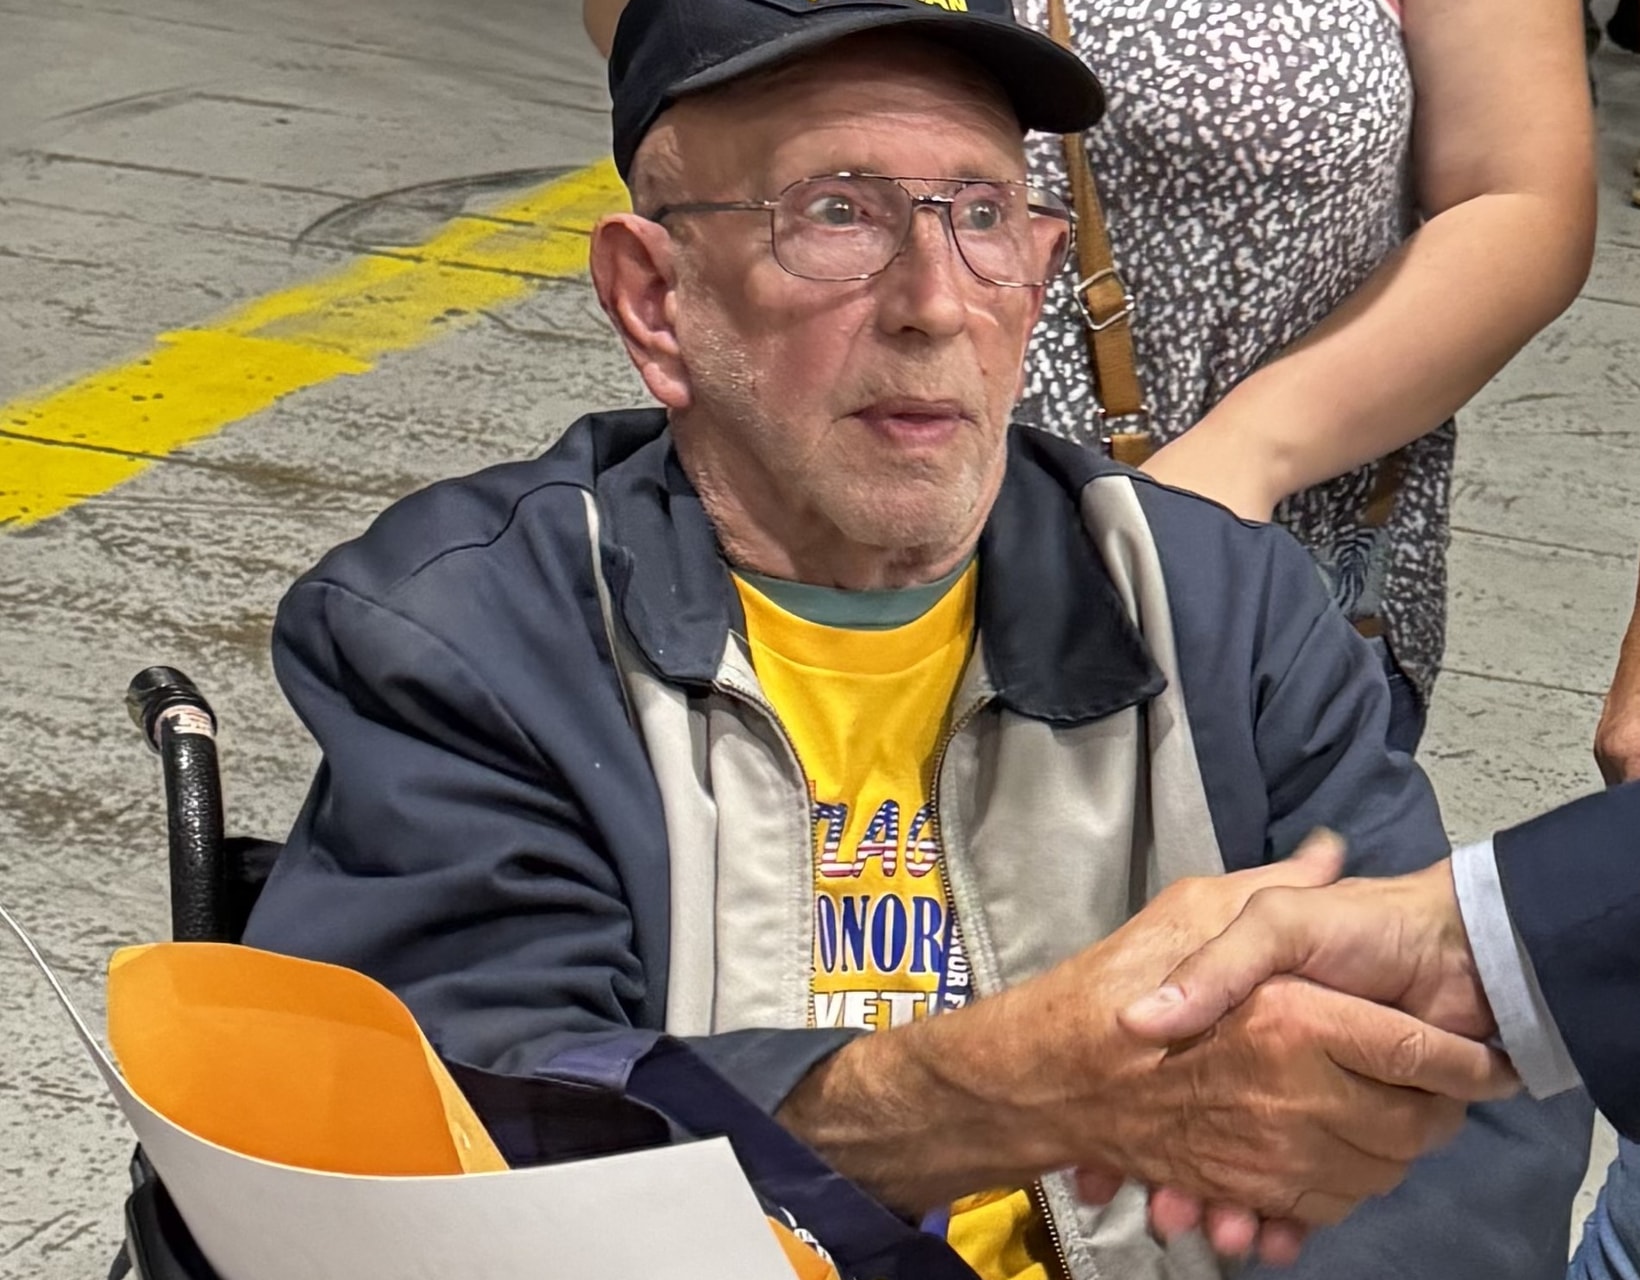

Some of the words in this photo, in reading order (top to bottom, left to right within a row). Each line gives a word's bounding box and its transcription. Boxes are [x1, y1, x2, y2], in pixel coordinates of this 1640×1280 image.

[811, 798, 941, 878] LAG
[814, 893, 945, 973] ONOR
[812, 991, 939, 1030] VET
